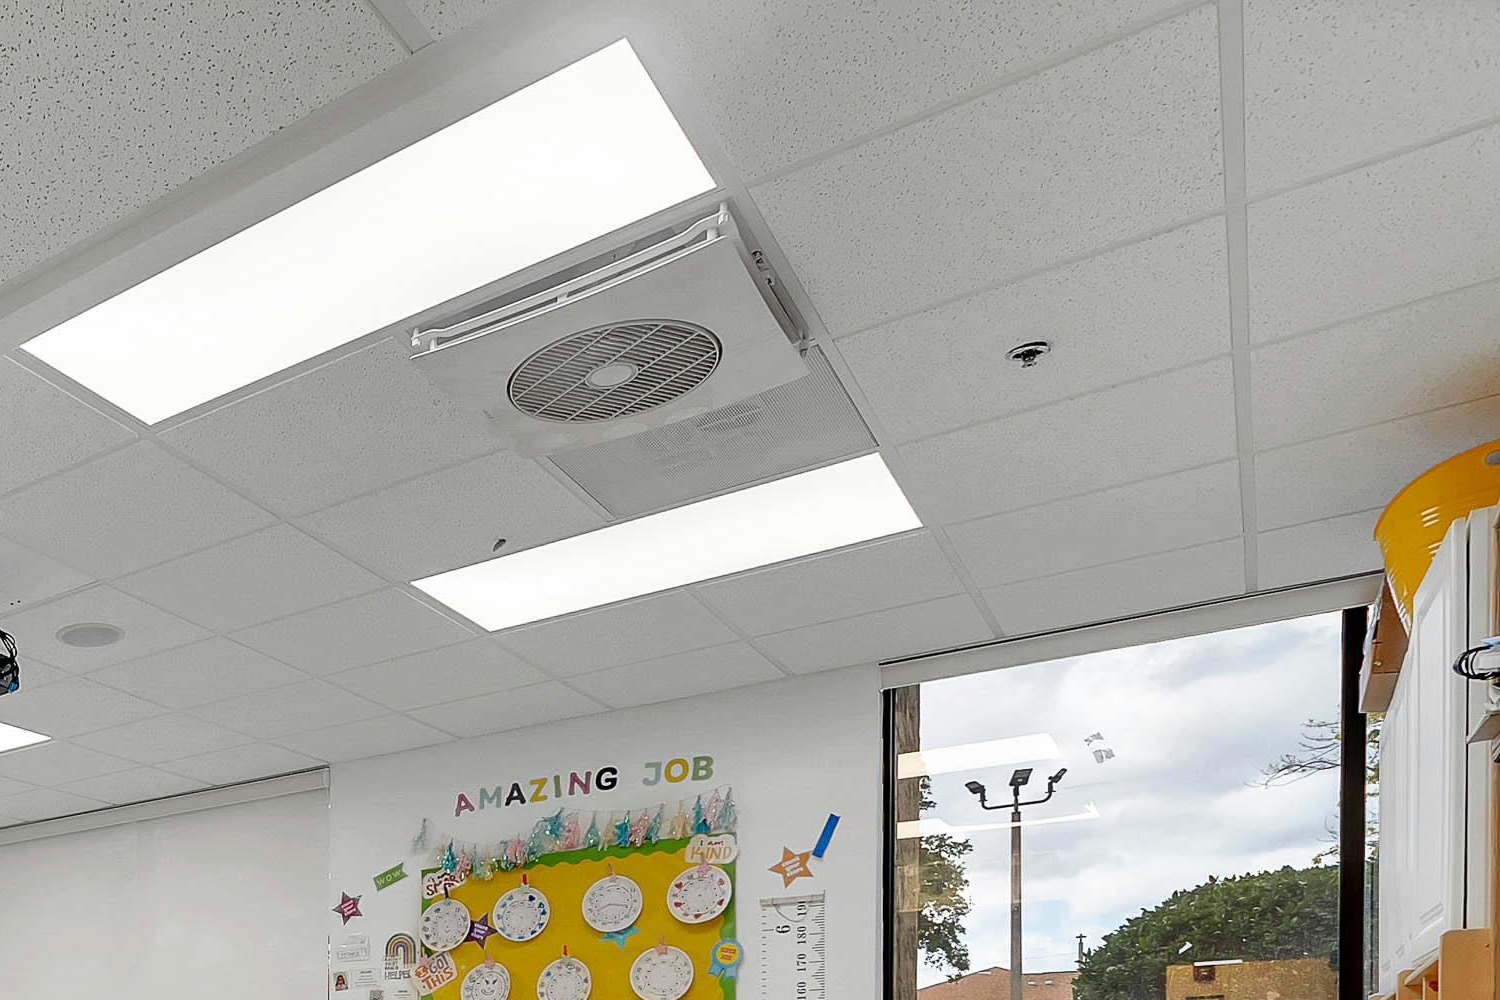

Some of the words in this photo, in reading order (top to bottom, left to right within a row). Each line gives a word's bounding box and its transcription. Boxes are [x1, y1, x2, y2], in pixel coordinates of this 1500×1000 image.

[454, 766, 619, 817] AMAZING
[642, 755, 715, 786] JOB
[775, 924, 791, 935] 6
[797, 926, 806, 945] 180
[797, 953, 806, 972] 170
[797, 981, 806, 1000] 160
